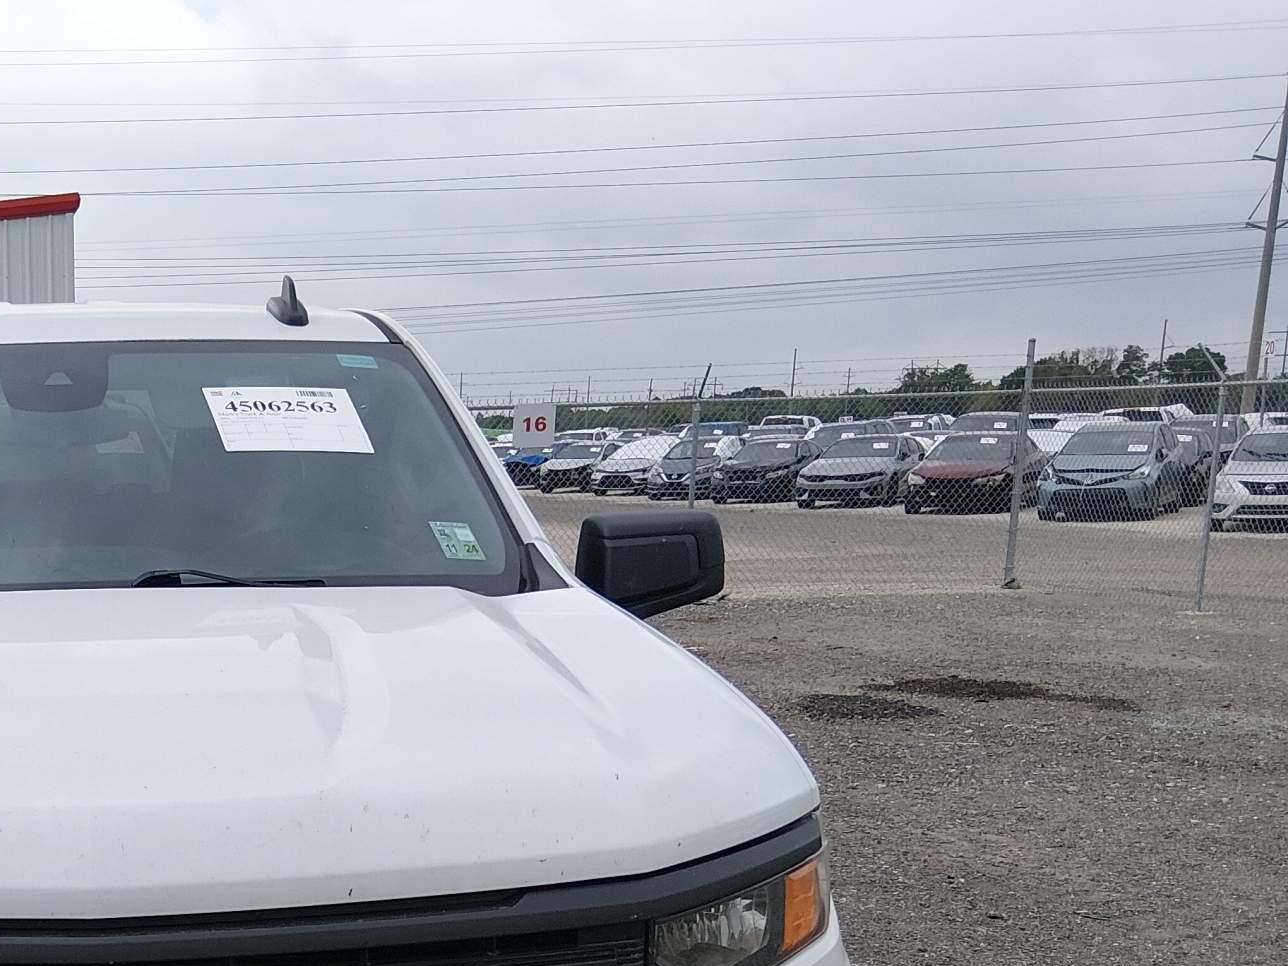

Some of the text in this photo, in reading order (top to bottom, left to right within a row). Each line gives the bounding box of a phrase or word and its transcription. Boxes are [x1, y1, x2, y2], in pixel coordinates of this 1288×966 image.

[1265, 340, 1275, 355] 20
[224, 400, 338, 414] 45062563
[522, 416, 547, 432] 16
[445, 543, 479, 554] 11 24
